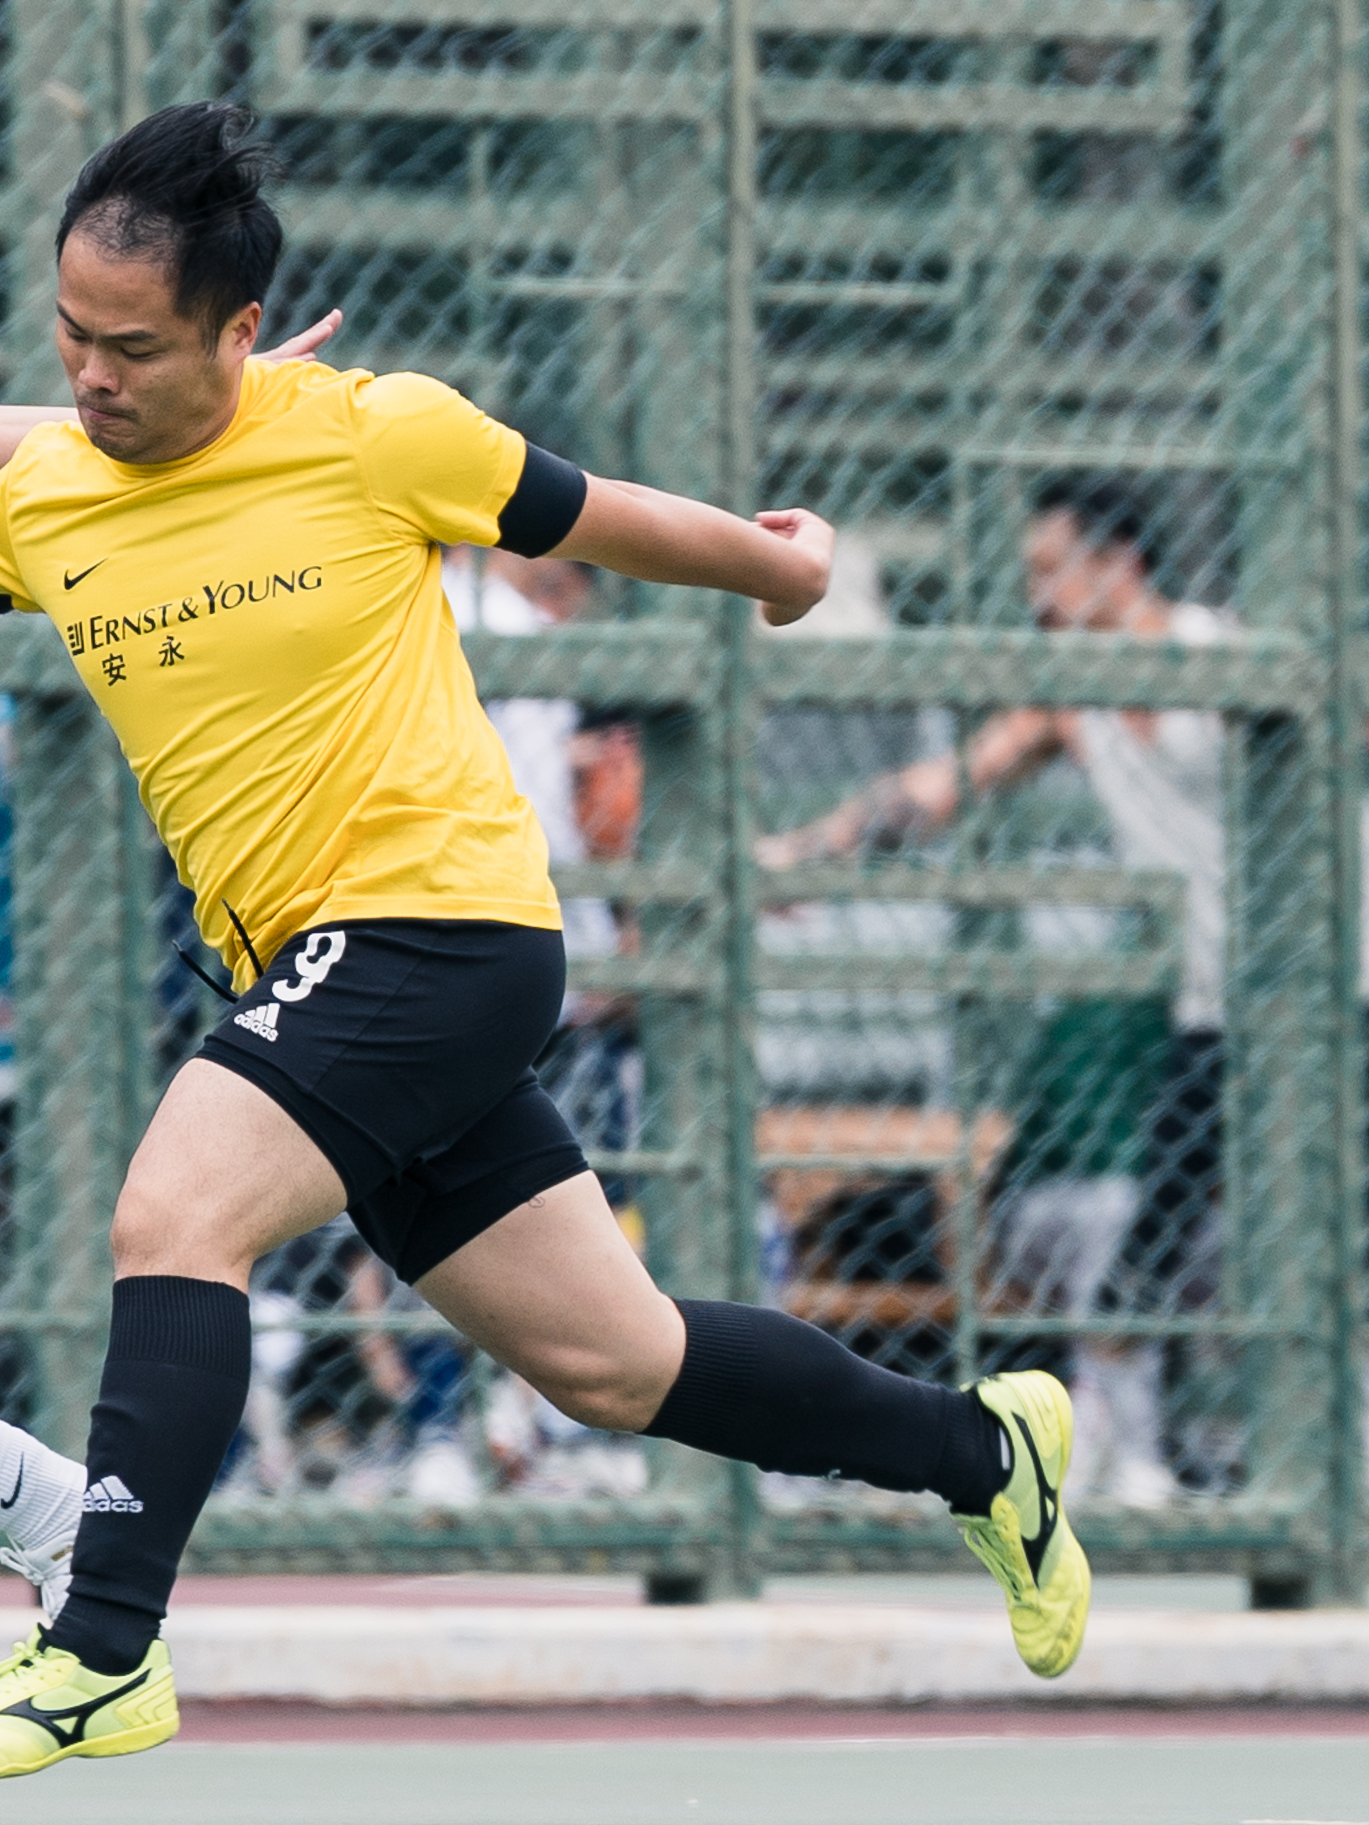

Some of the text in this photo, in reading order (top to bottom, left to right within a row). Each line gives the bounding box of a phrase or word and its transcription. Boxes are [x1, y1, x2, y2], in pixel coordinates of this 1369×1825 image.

[90, 566, 322, 650] ERNST & YOUNG
[272, 930, 346, 1002] 9
[234, 1013, 279, 1042] adidas
